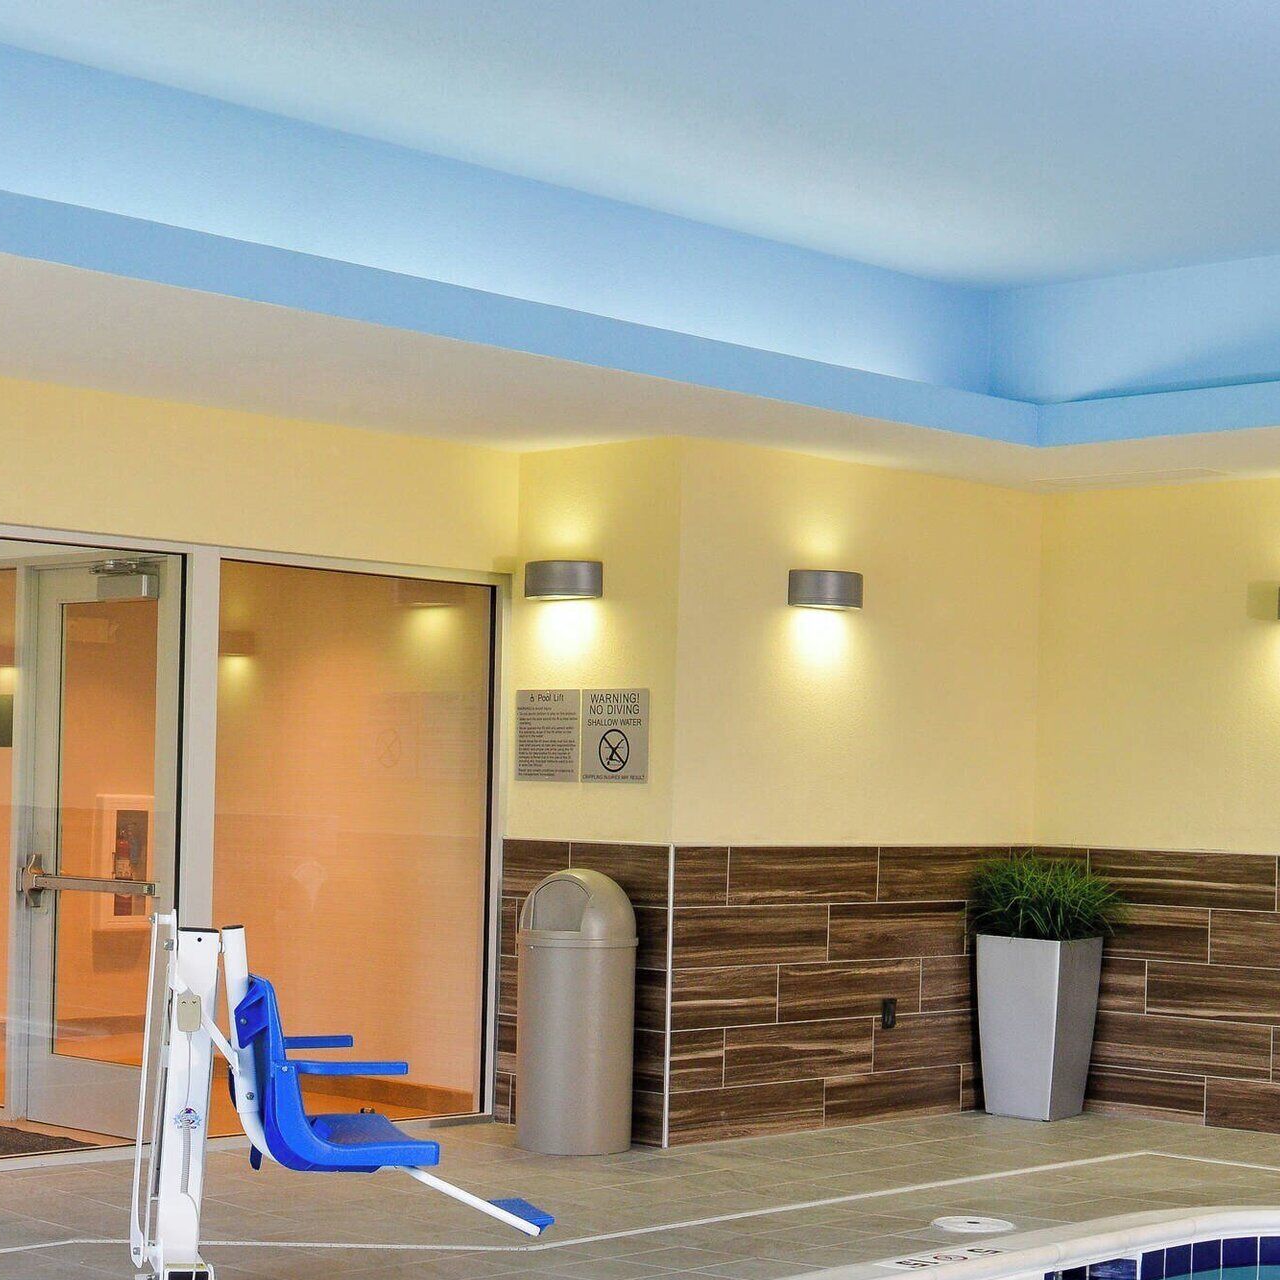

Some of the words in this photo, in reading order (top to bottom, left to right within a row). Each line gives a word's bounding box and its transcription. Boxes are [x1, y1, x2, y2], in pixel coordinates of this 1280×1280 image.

[537, 693, 551, 702] Pool
[590, 692, 640, 704] WARNING!
[589, 704, 604, 715] NO
[606, 704, 640, 715] DIVING
[587, 718, 619, 727] SHALLOW
[619, 718, 642, 727] WATER
